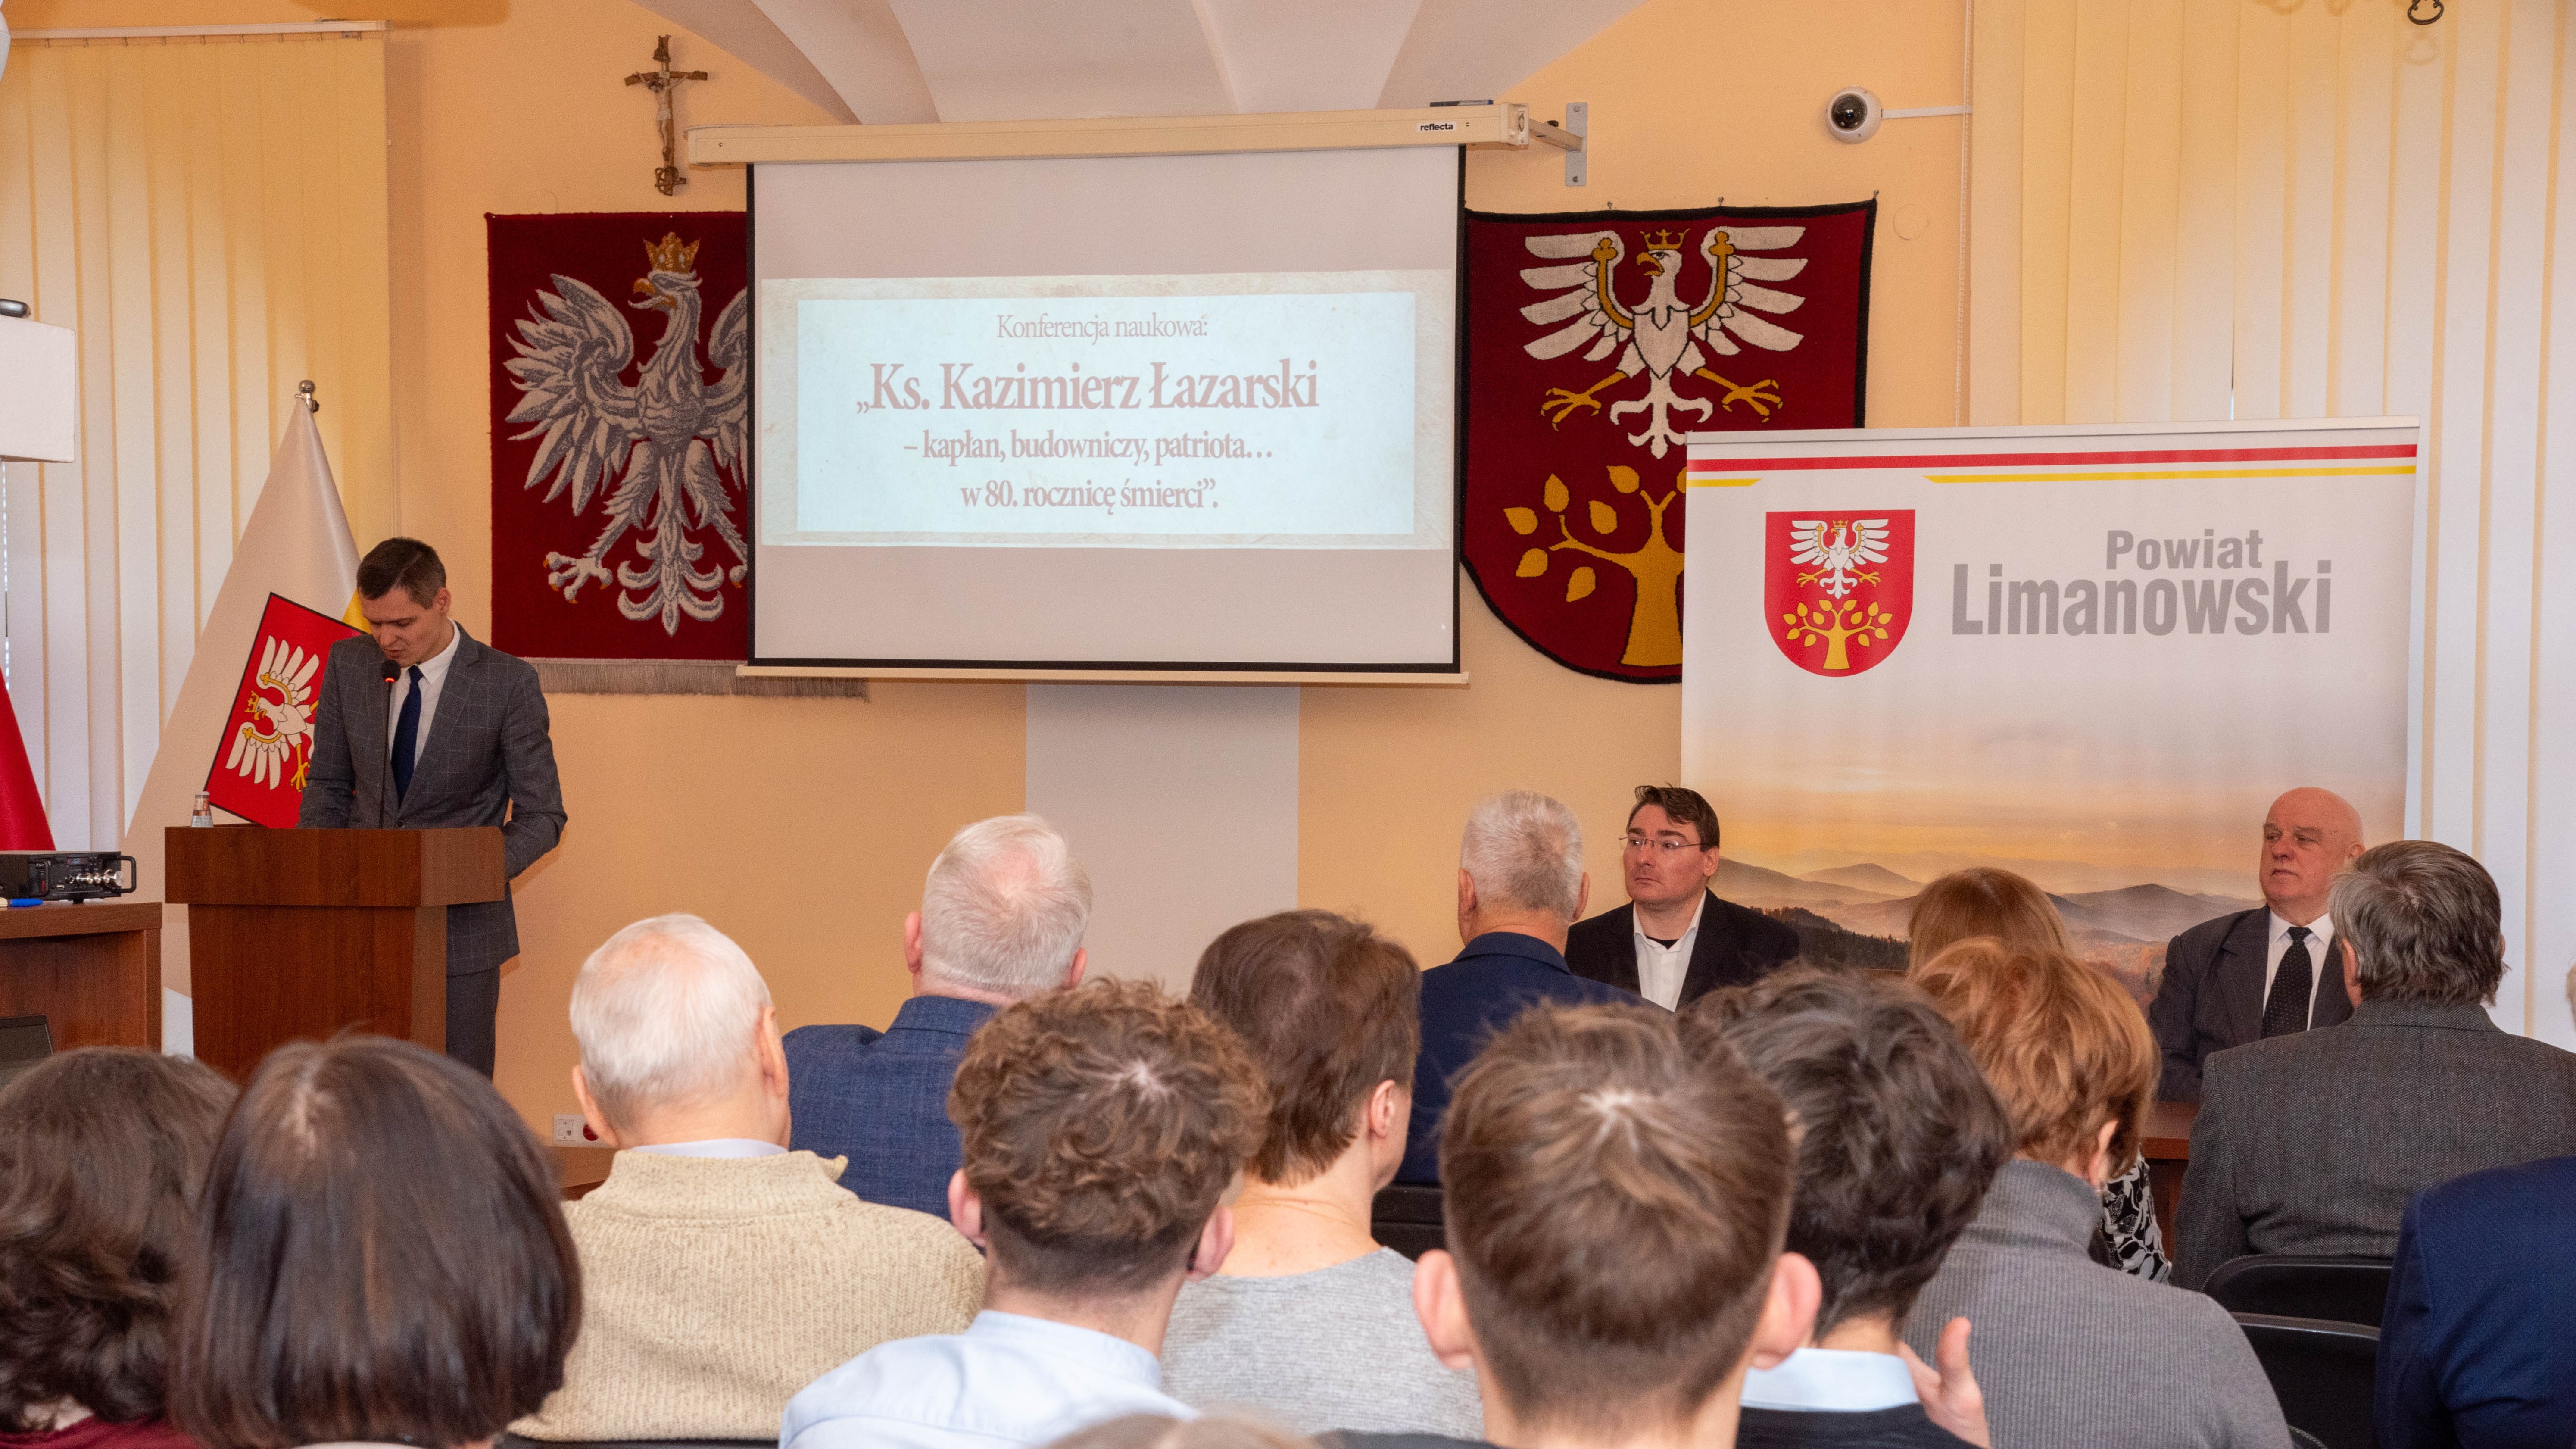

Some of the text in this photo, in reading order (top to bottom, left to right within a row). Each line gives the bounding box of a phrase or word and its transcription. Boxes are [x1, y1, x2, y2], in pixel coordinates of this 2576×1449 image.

[997, 312, 1208, 345] Konferencja naukowa:
[856, 359, 1319, 414] „Ks. Kazimierz Łazarski
[922, 429, 1006, 467] kapłan,
[1010, 429, 1150, 467] budowniczy,
[960, 487, 982, 507] w
[985, 480, 1018, 507] 80.
[1023, 479, 1116, 516] rocznicę
[2106, 528, 2264, 570] Powiat
[1952, 560, 2332, 637] Limanowski
